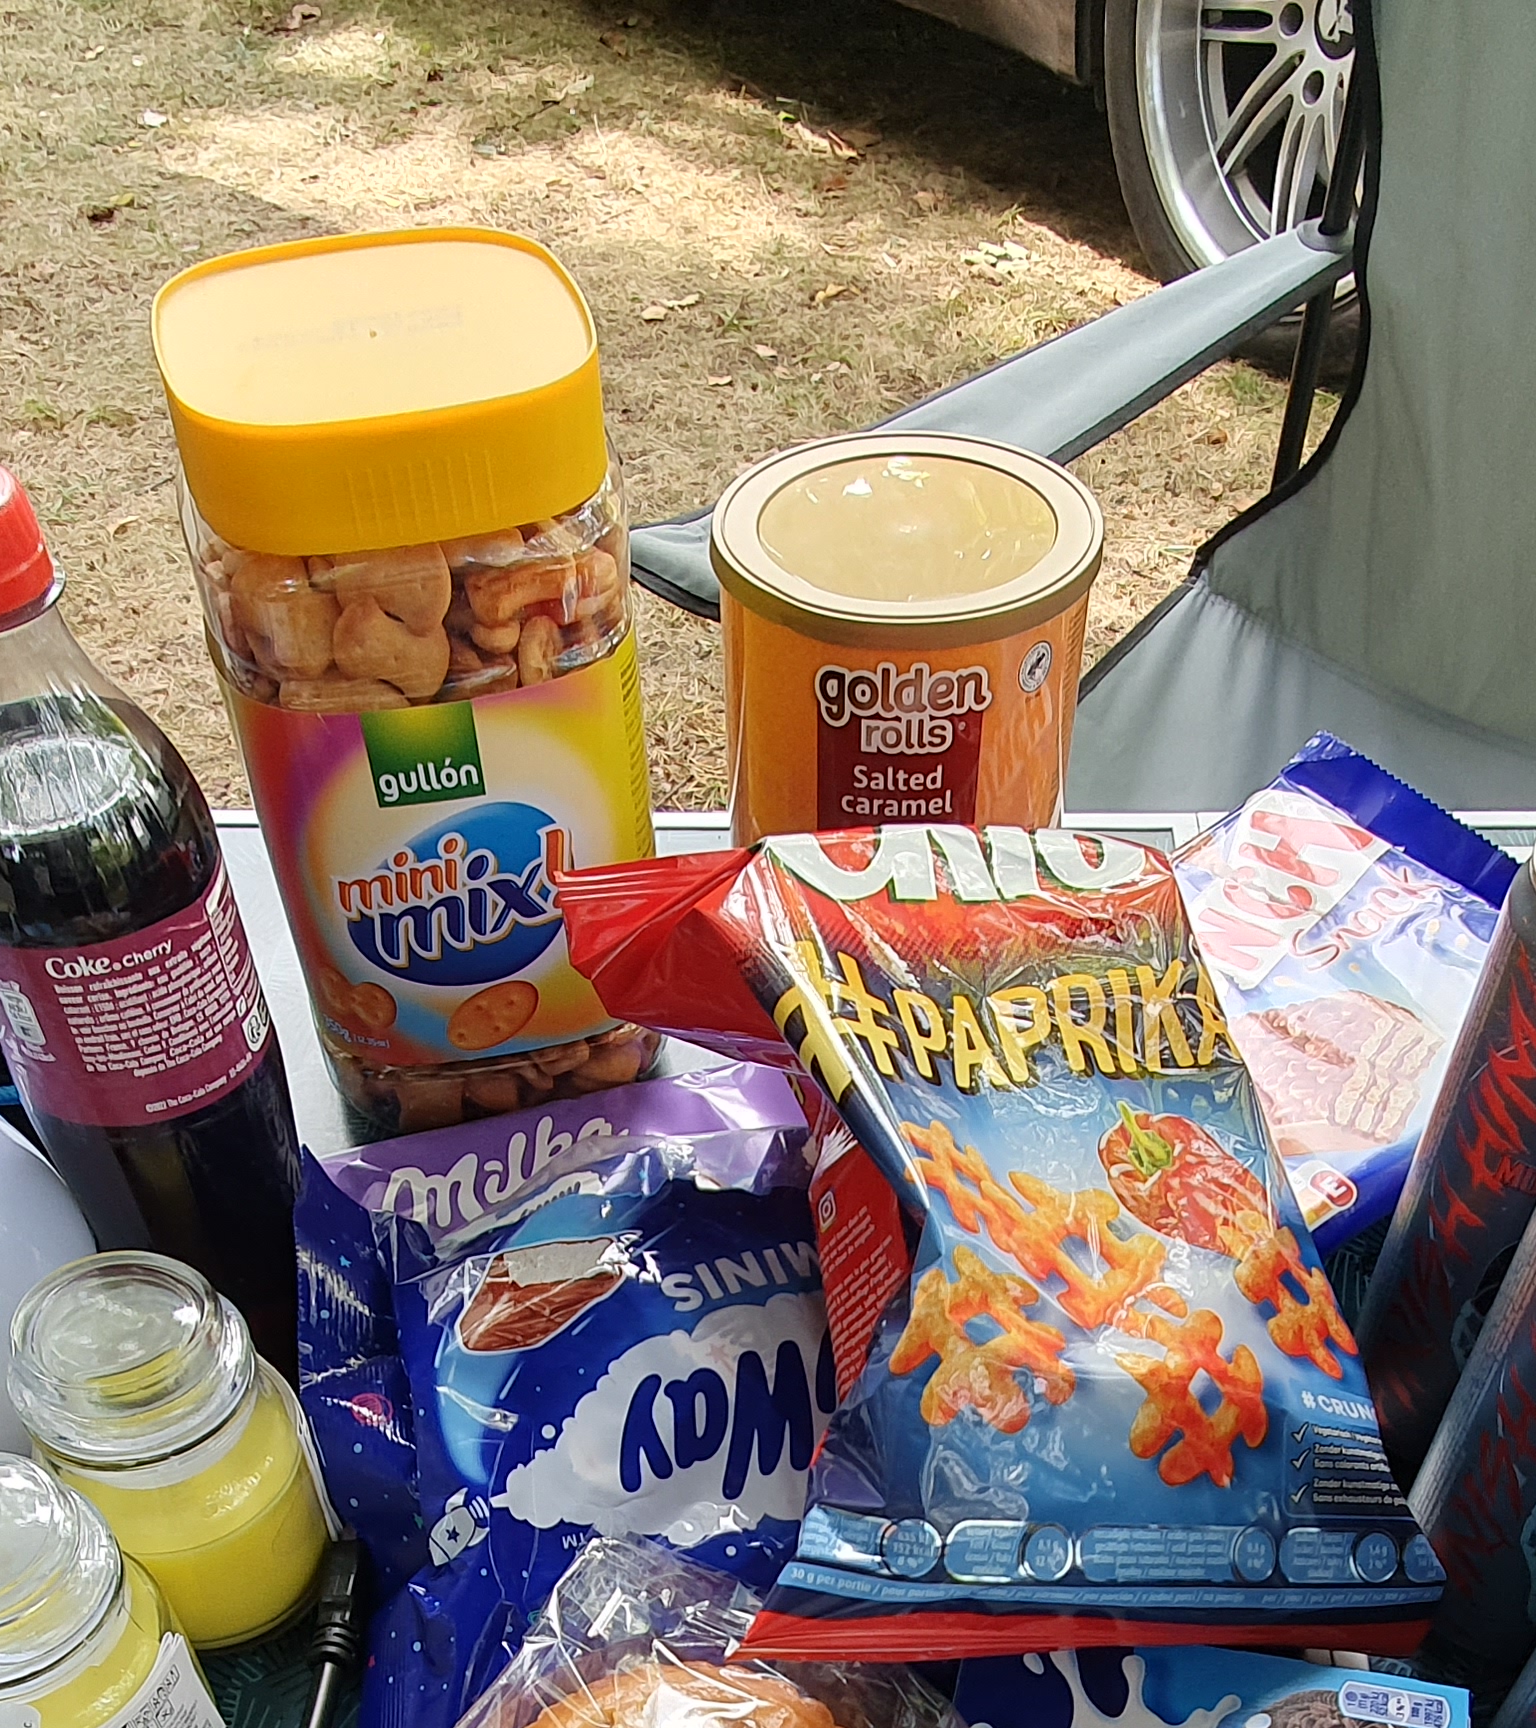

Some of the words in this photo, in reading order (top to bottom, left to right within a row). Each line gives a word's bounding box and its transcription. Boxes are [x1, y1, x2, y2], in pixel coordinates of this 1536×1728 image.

[817, 662, 991, 727] golden
[861, 715, 953, 755] rolls
[378, 756, 480, 806] gullón
[841, 790, 953, 817] caramel
[853, 764, 943, 791] Salted
[338, 833, 466, 916] mini
[378, 824, 575, 967] mix!
[1286, 861, 1454, 974] Snack
[45, 955, 113, 980] Coke
[122, 939, 174, 969] Cherry
[795, 940, 1242, 1096] #PAPRIKA
[382, 1115, 630, 1228] Milka
[661, 1237, 823, 1314] MINIS
[618, 1340, 814, 1500] Way
[790, 1567, 806, 1582] 30
[806, 1572, 817, 1586] g
